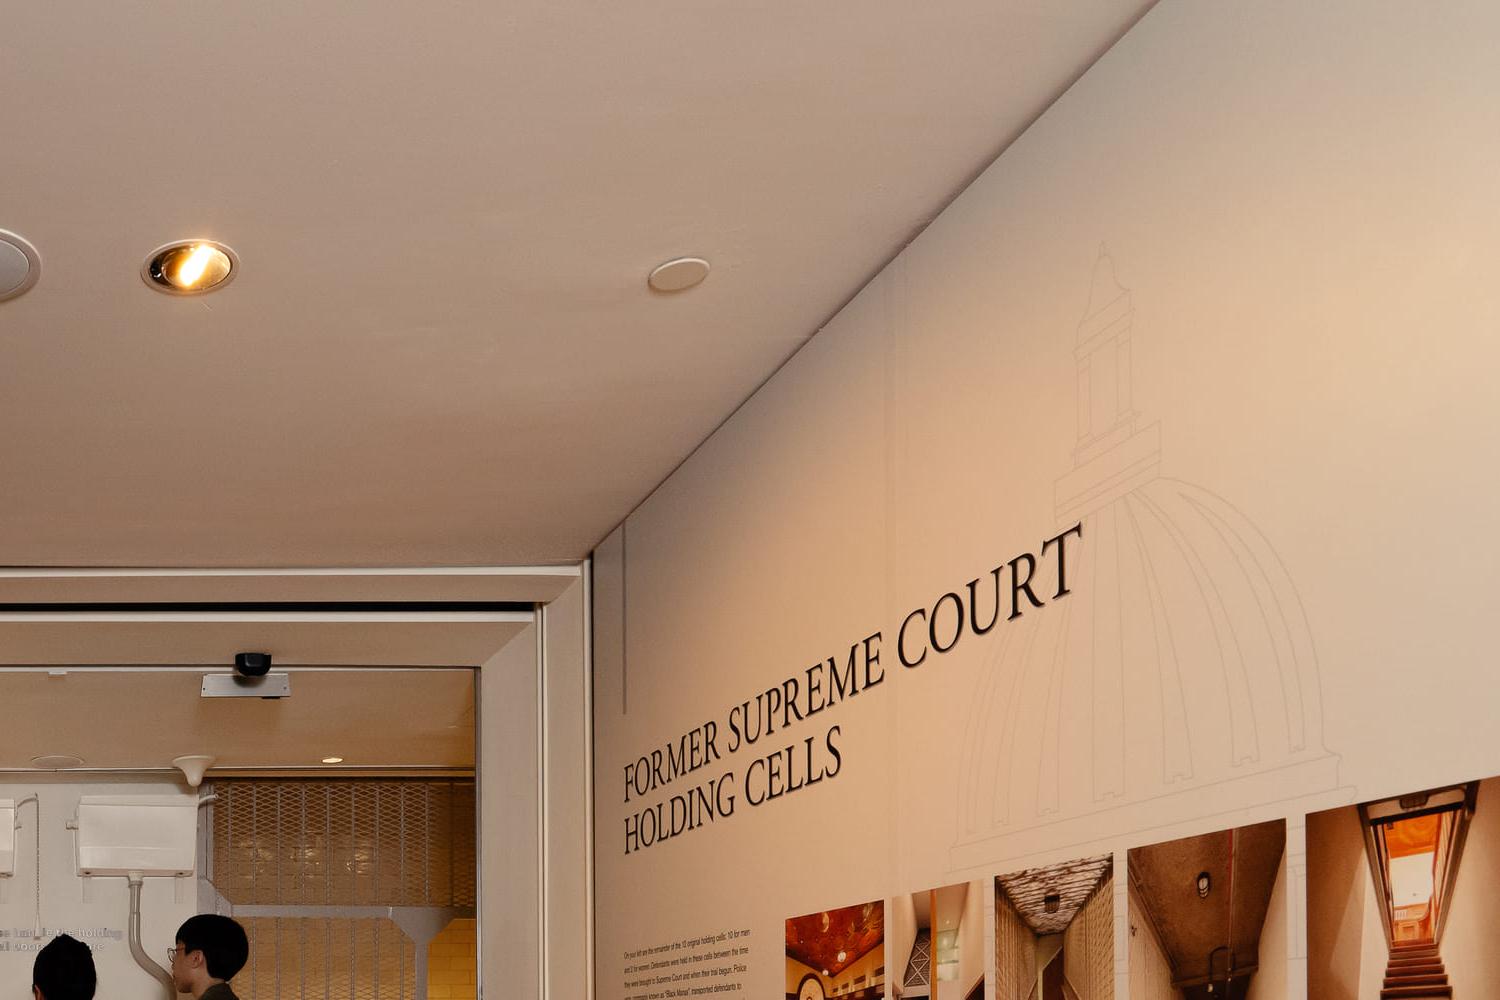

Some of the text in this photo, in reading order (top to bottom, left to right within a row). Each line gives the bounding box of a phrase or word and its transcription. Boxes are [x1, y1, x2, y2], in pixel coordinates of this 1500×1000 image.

[623, 521, 1082, 803] FORMER SUPREME COURT
[623, 725, 843, 855] HOLDING CELLS
